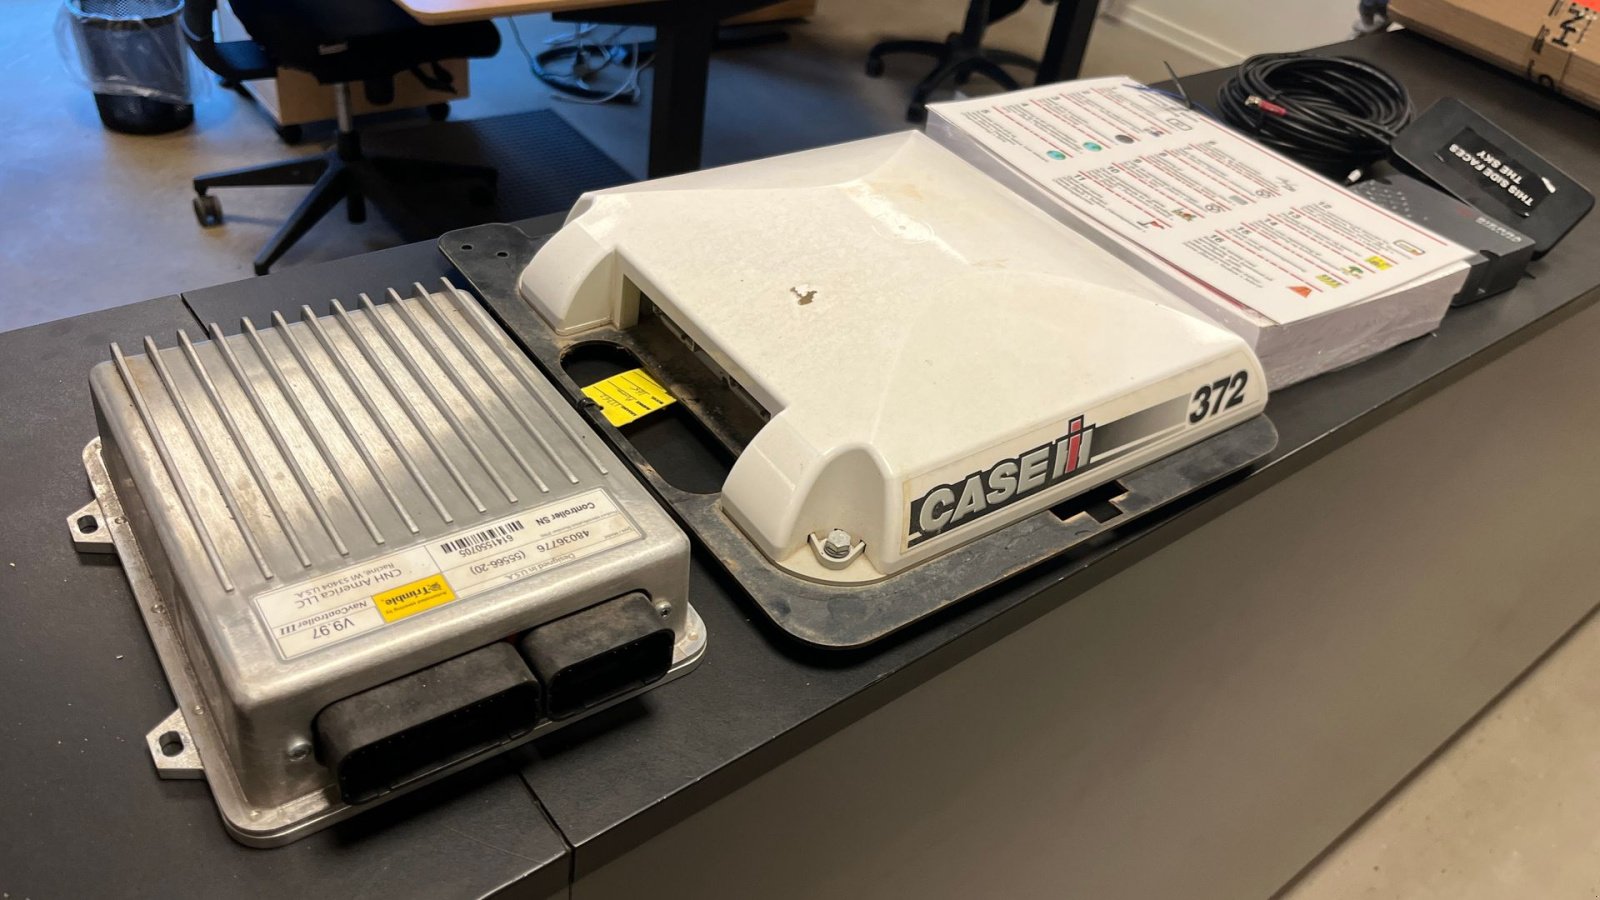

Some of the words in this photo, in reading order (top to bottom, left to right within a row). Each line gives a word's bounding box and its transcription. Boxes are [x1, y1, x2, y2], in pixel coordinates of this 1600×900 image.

[1449, 143, 1484, 175] FACES
[1476, 150, 1501, 169] SKY
[1483, 168, 1509, 190] SIDE
[1499, 166, 1523, 185] THE
[1508, 184, 1534, 206] THIS
[1189, 370, 1248, 424] 372
[919, 450, 1051, 532] CASE
[534, 515, 551, 526] SN
[549, 500, 596, 521] Controller
[457, 533, 514, 558] 6141550705
[534, 528, 592, 553] 48036776
[361, 561, 395, 577] Racine,
[467, 549, 527, 576] (55566-20)
[536, 551, 576, 569] Designed
[320, 576, 350, 590] 53404
[349, 572, 362, 581] WI
[372, 567, 403, 583] CNH
[503, 568, 529, 581] U.S.A.
[293, 586, 321, 599] U.S.A.
[319, 577, 373, 601] America
[383, 585, 431, 608] Trimble
[294, 595, 319, 609] LLC
[295, 599, 368, 629] NavController
[308, 615, 355, 640] V9.97
